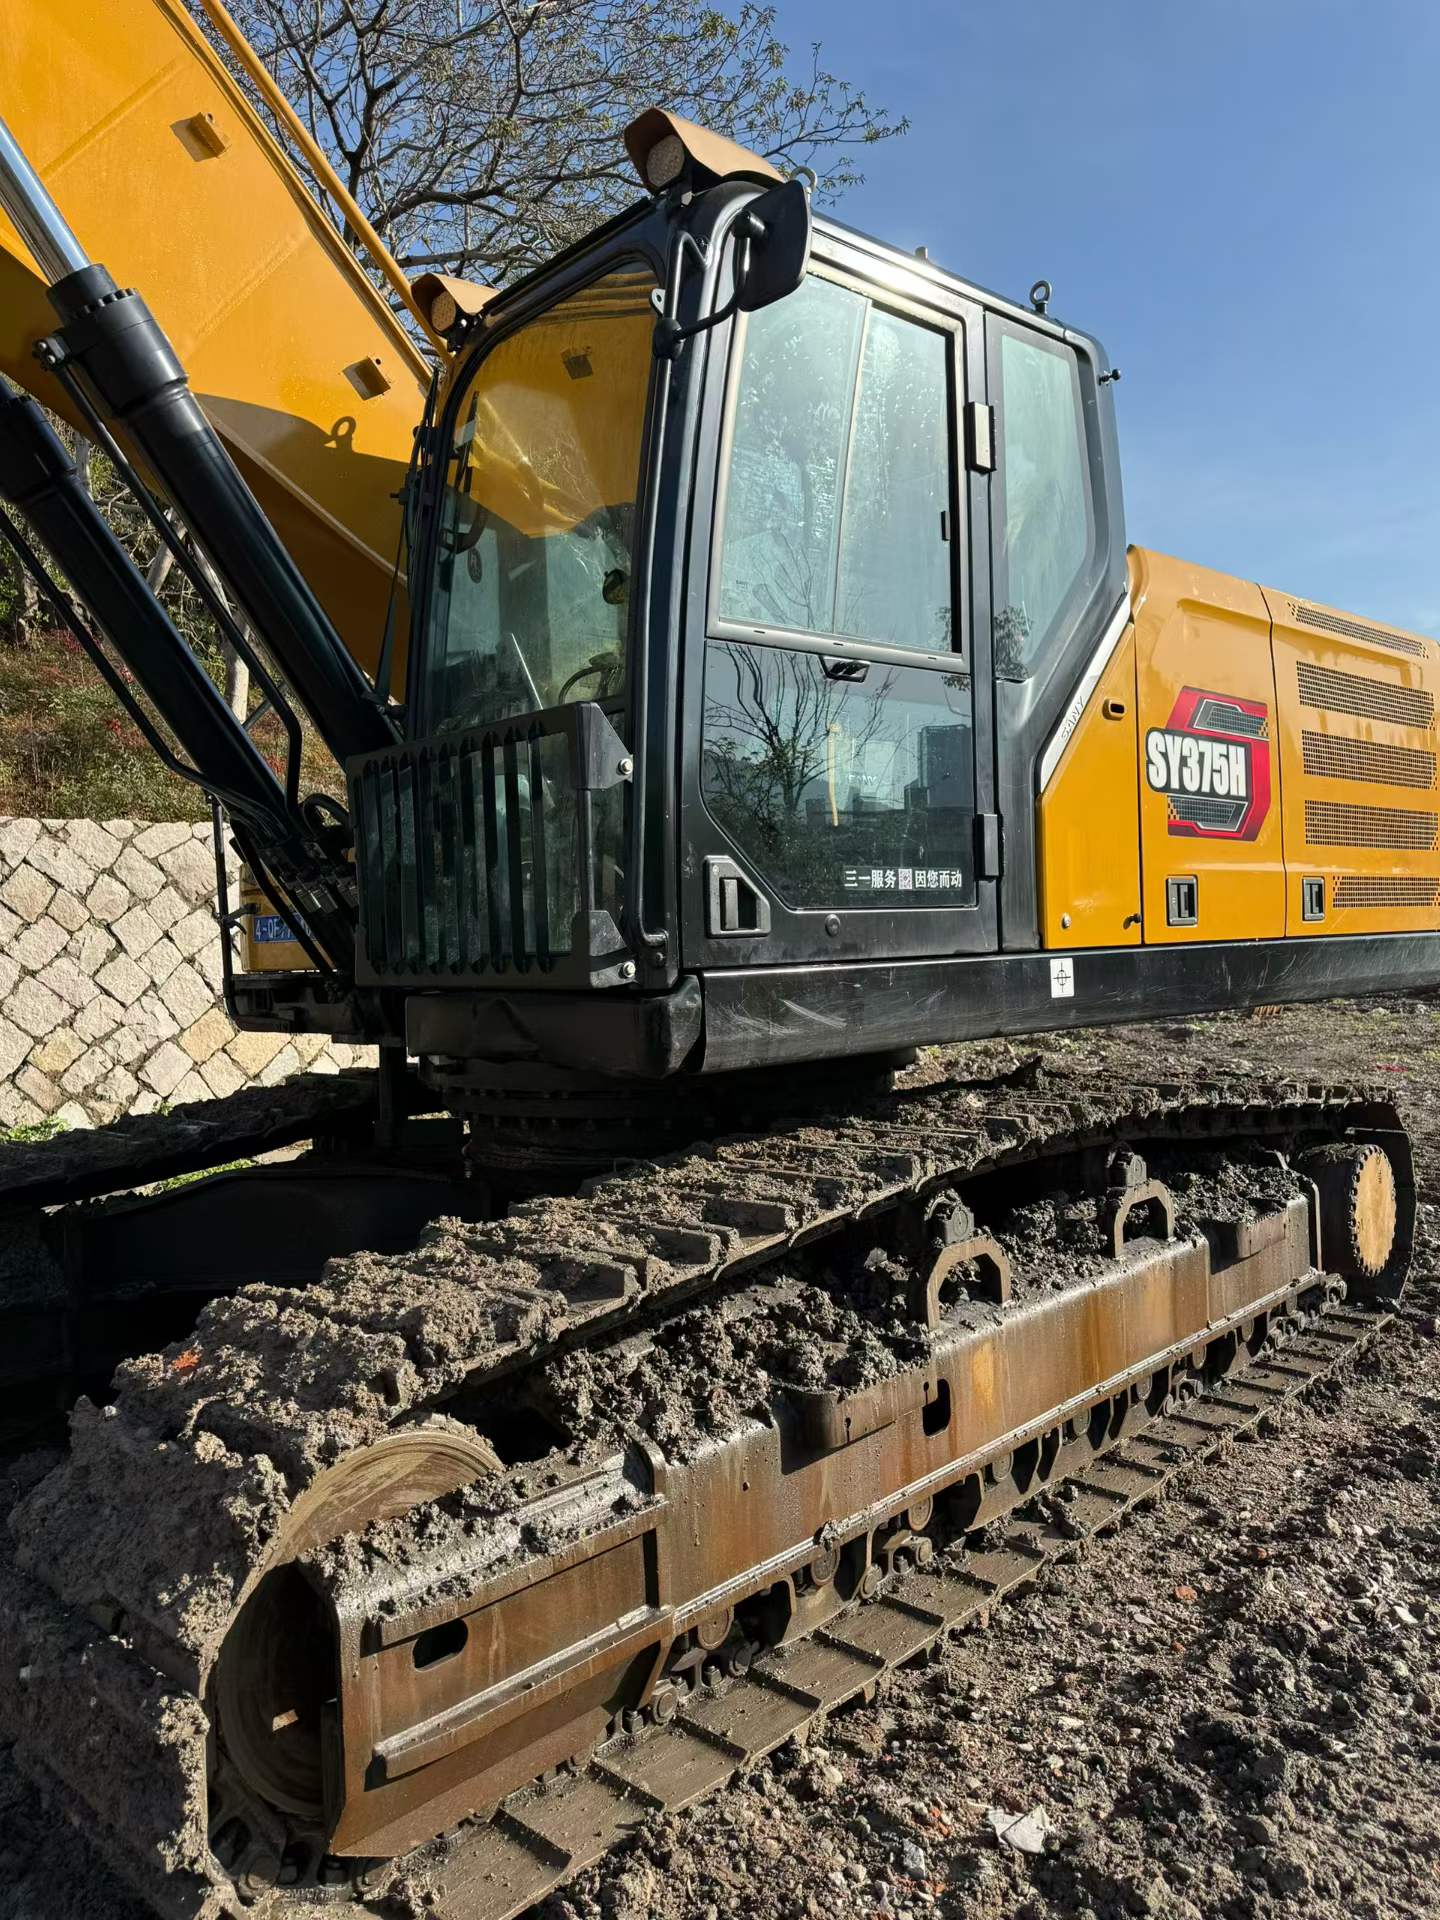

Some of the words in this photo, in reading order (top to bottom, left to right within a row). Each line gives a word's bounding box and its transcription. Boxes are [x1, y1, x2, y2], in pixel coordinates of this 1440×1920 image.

[1061, 695, 1084, 741] SANY
[1147, 730, 1247, 797] SY375H
[844, 869, 897, 889] 三一服务
[914, 870, 963, 889] 因您而动
